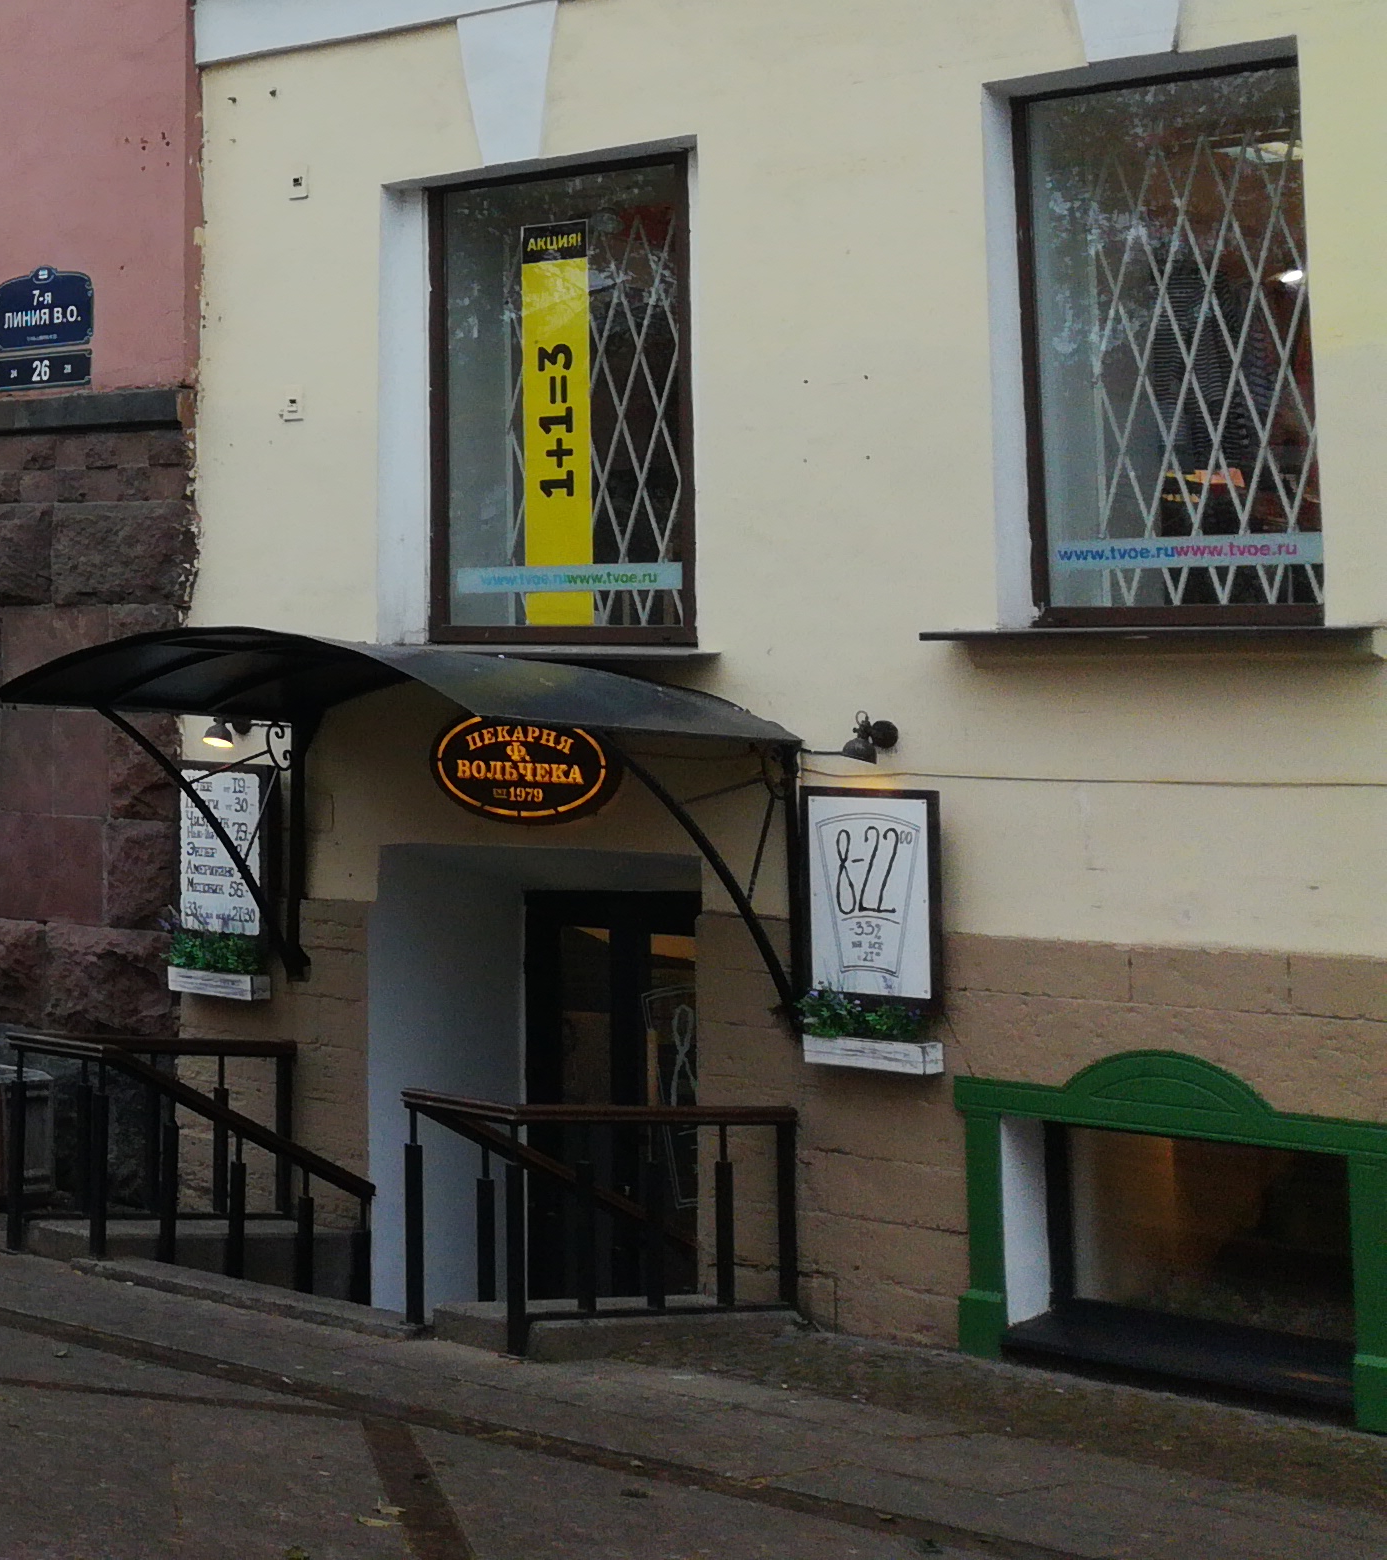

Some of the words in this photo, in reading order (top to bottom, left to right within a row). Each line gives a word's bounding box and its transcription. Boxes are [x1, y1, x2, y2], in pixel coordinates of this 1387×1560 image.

[526, 231, 582, 251] АКЦИЯ!
[32, 289, 52, 306] 7-я
[3, 308, 49, 329] ЛИНИЯ
[53, 305, 82, 323] В.О.
[31, 359, 50, 382] 26
[537, 342, 575, 499] 1+1=3
[1057, 544, 1175, 561] www.tvoe.ru
[1174, 541, 1298, 558] www.tvoe.ru
[565, 570, 658, 585] www.tvoe.ru
[465, 725, 575, 755] ПЕКАРНЯ
[505, 741, 531, 762] Ф.
[456, 759, 585, 785] ВОЛЬЧЕКА
[508, 786, 544, 802] 1979
